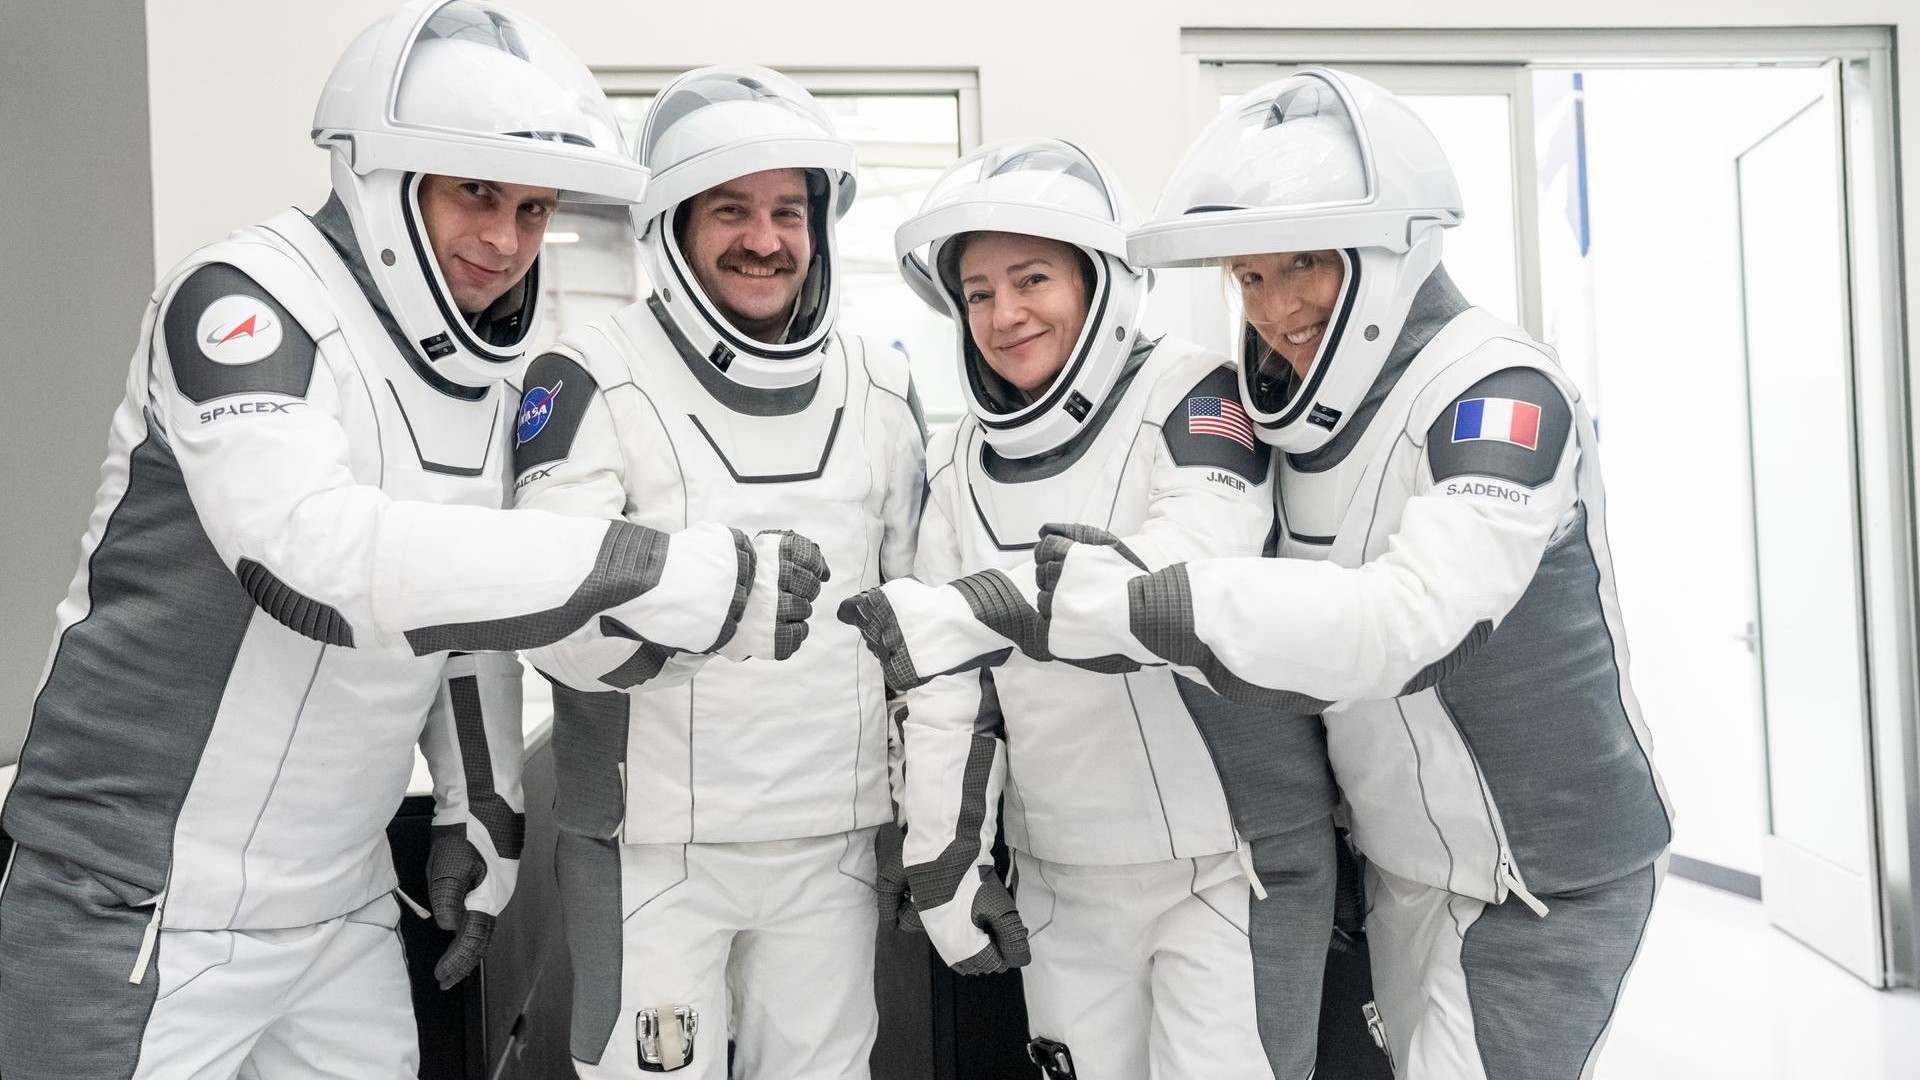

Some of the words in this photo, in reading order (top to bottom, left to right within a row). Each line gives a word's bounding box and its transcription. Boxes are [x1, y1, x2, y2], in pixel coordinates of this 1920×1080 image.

[200, 402, 308, 424] SPACEX
[1206, 471, 1246, 493] J.MEIR
[1446, 483, 1531, 506] S.ADENOT
